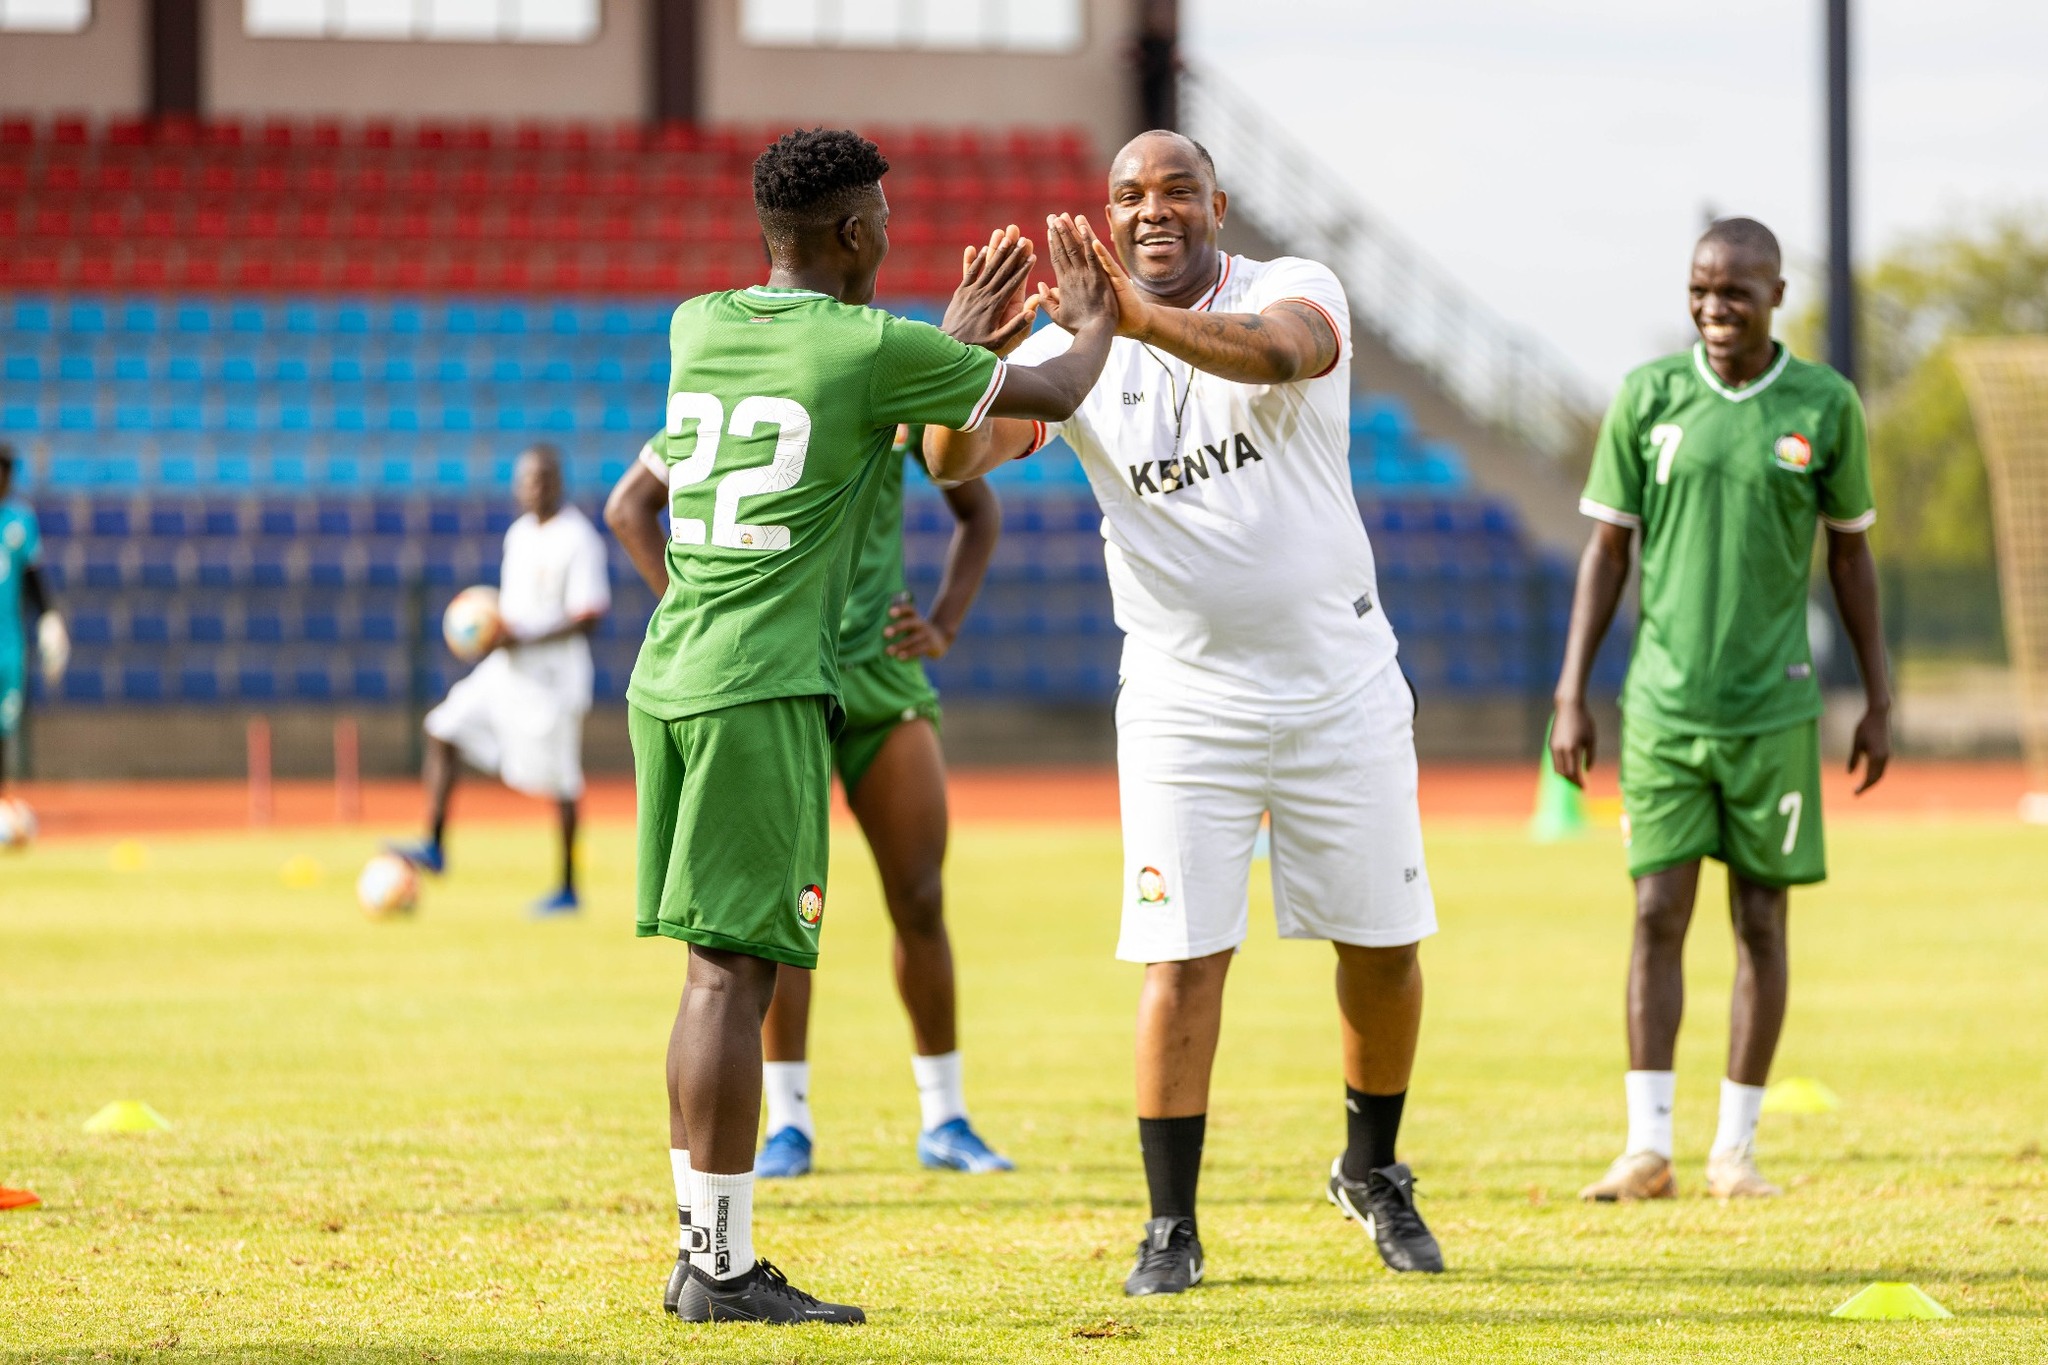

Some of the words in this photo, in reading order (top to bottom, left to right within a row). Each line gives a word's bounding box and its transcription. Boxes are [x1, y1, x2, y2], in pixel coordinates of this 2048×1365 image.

[666, 391, 812, 551] 22
[1650, 424, 1684, 486] 7
[1778, 790, 1803, 856] 7
[715, 1195, 730, 1251] TAPEDESIGN
